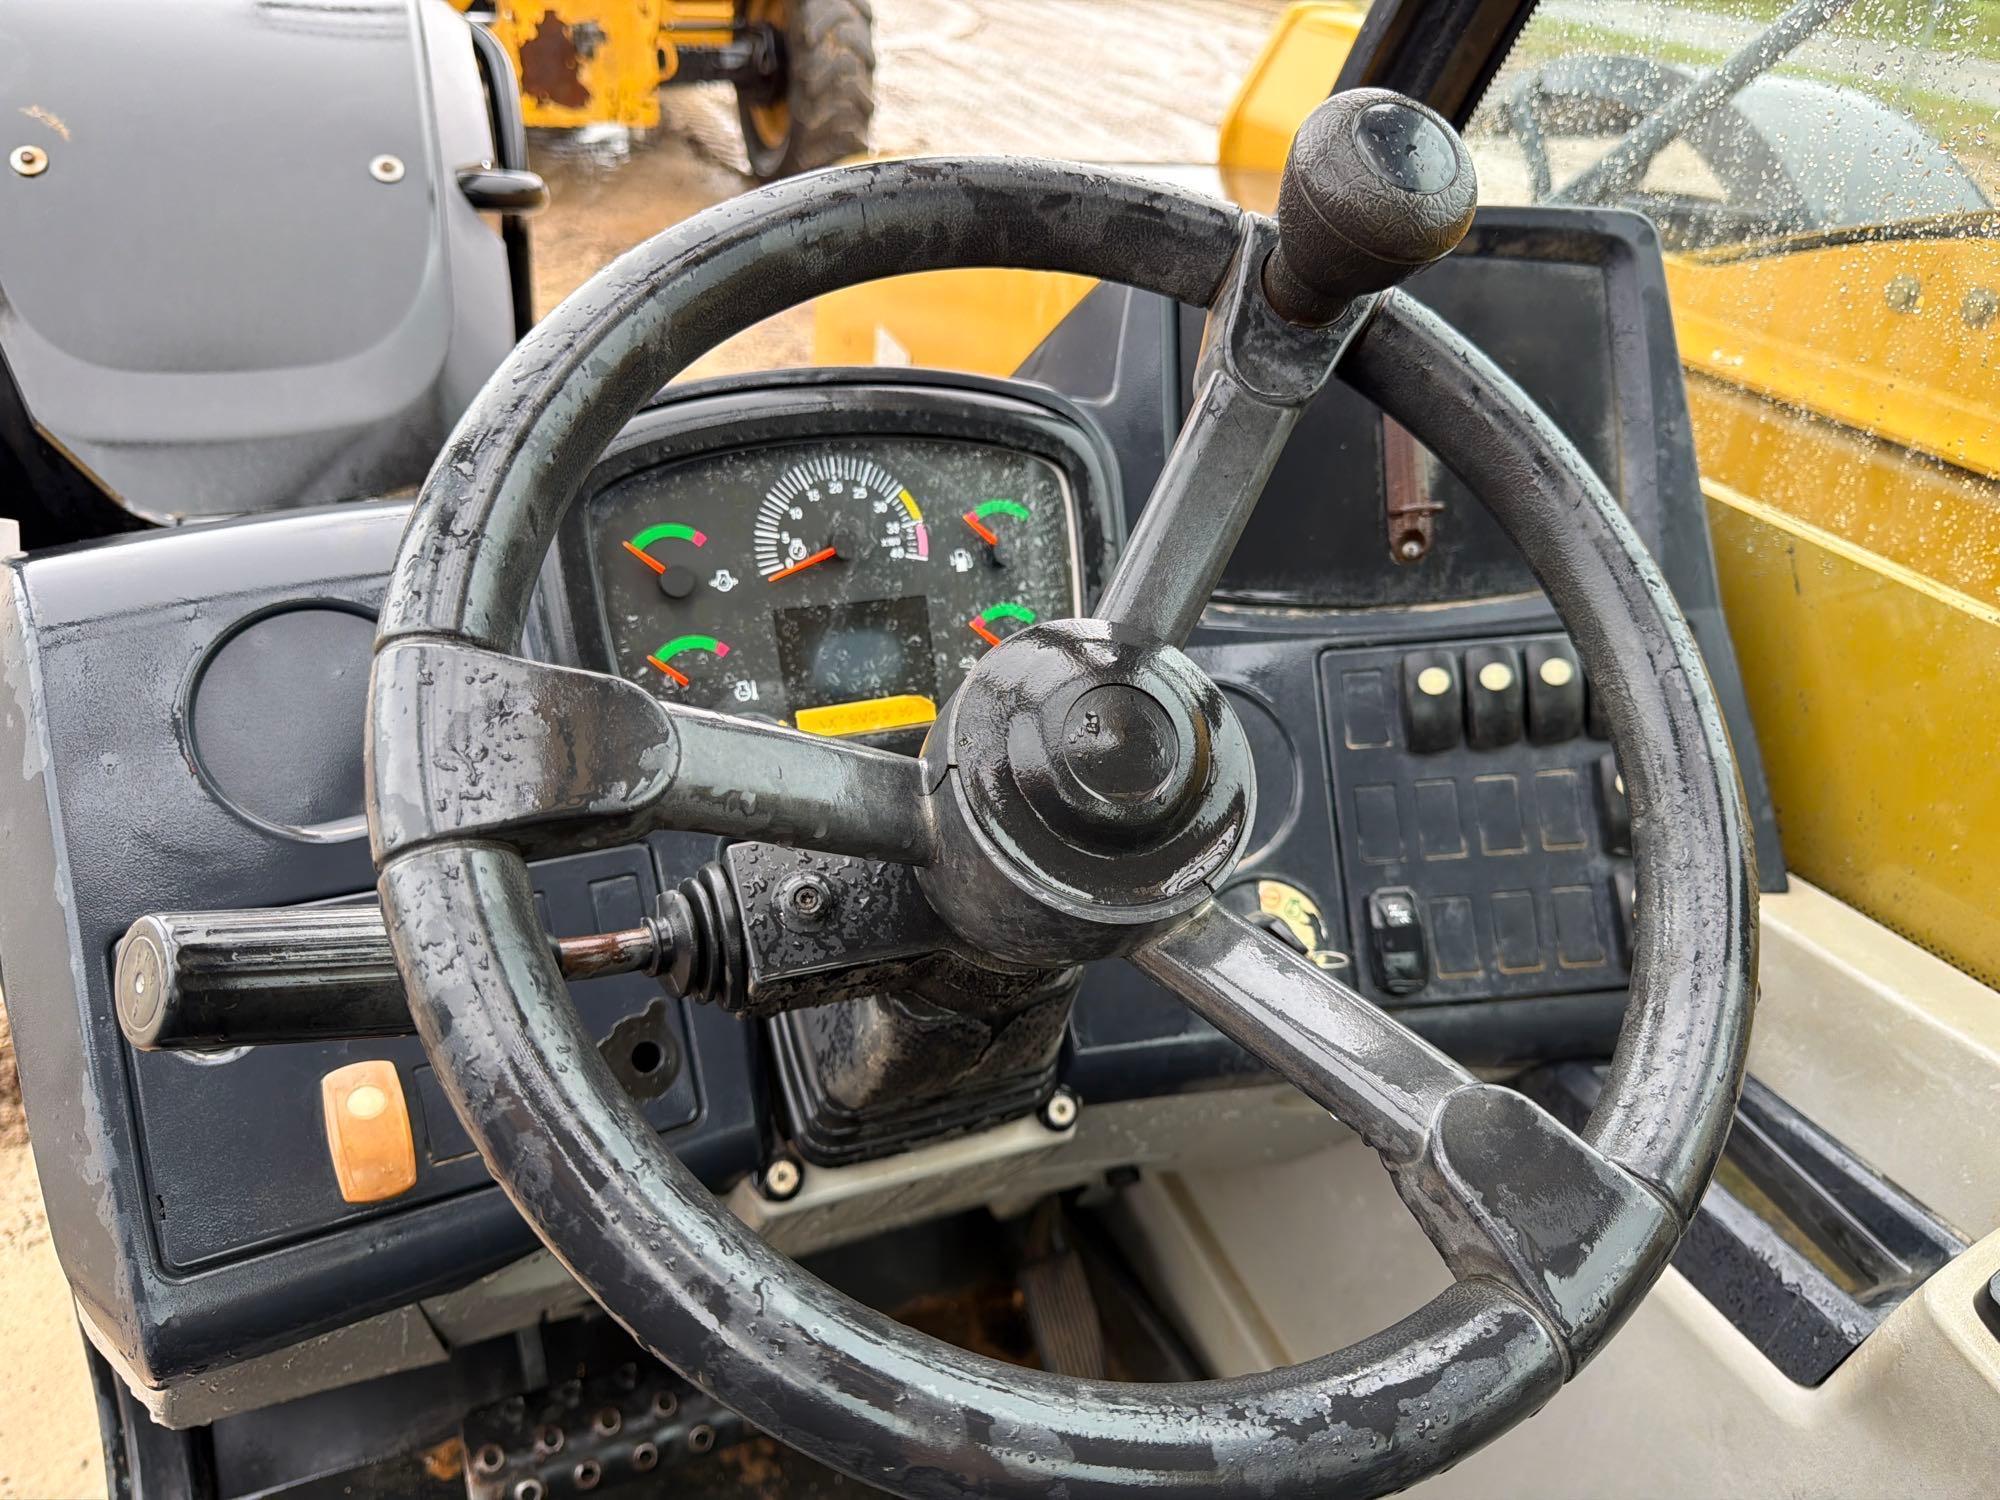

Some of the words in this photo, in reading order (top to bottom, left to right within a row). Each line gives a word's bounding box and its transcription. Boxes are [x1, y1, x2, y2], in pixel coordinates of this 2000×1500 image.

[828, 481, 843, 494] 20
[852, 486, 867, 499] 25
[806, 489, 820, 502] 15
[789, 506, 803, 520] 10
[873, 501, 888, 513] 30
[781, 531, 790, 544] 5
